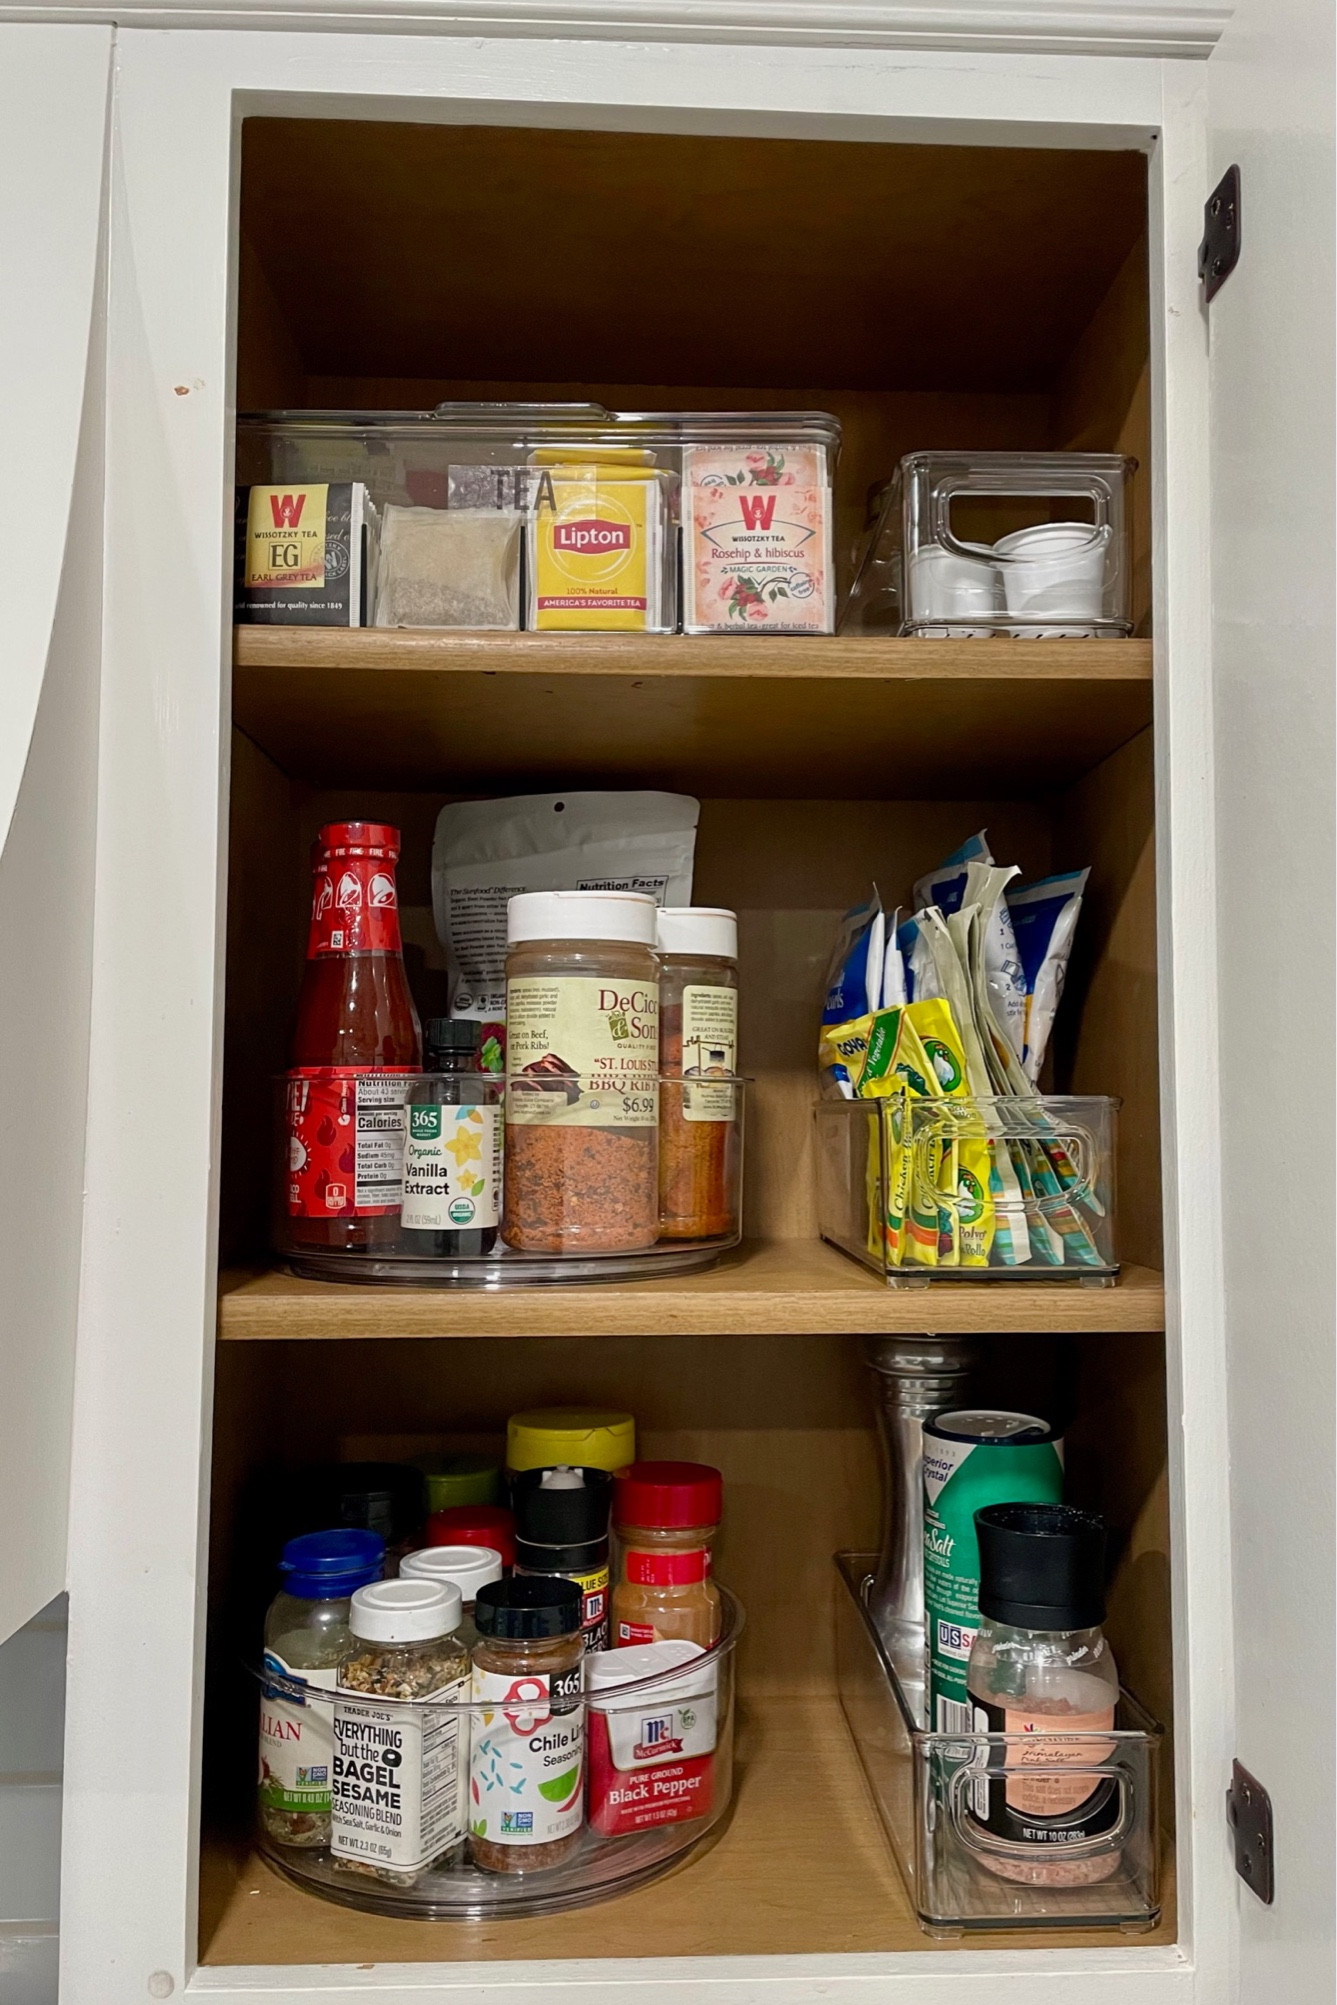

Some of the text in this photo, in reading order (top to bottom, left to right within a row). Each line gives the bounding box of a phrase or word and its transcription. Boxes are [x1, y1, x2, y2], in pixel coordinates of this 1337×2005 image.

[491, 470, 558, 512] TEA
[254, 531, 299, 540] WISSOTZKY
[302, 530, 318, 538] TEA
[560, 527, 624, 548] Lipton
[732, 535, 786, 543] WISSOTZKY TEA
[270, 543, 299, 568] EG
[711, 548, 805, 562] Rosehip & hibiscus
[251, 574, 273, 582] EARL
[275, 574, 298, 582] GREY
[300, 574, 317, 582] TEA
[589, 587, 618, 596] Natural
[246, 602, 342, 612] renowned for quality since 1849
[544, 598, 641, 607] AMERICA'S FAVORITE TEA
[369, 849, 384, 857] FIRE
[579, 878, 664, 890] Nutrition Facts
[531, 1029, 549, 1040] Beef,
[837, 1037, 868, 1058] GOYA
[358, 1088, 380, 1096] About
[622, 1096, 654, 1115] $6.99
[358, 1117, 402, 1129] Calories
[412, 1111, 438, 1128] 365
[357, 1152, 395, 1161] Sodium 45mg
[409, 1144, 442, 1160] Organic
[357, 1162, 372, 1170] Total
[406, 1162, 448, 1178] Vanilla
[357, 1172, 387, 1180] Protein 0g
[405, 1181, 450, 1196] Extract
[582, 1622, 608, 1646] BLAC
[555, 1673, 580, 1698] 365
[344, 1706, 391, 1722] TRADER JOE'S
[261, 1712, 302, 1742] LIAN
[334, 1717, 402, 1749] EVERYTHING
[529, 1734, 568, 1753] Chile
[636, 1741, 678, 1758] McCormick
[340, 1741, 380, 1763] but the
[333, 1755, 401, 1790] BAGEL
[629, 1767, 684, 1785] PURE GROUND
[332, 1778, 401, 1810] SESAME
[609, 1776, 702, 1805] Black Pepper
[332, 1797, 402, 1826] SEASONING BLEND
[342, 1816, 402, 1838] Sea Salt, Garlic & Onion
[1023, 1827, 1036, 1839] NET
[1036, 1829, 1048, 1840] WT
[1049, 1831, 1057, 1842] 10
[1058, 1831, 1067, 1842] OZ
[338, 1835, 348, 1846] NET
[360, 1840, 369, 1852] 2.3
[370, 1842, 378, 1854] OZ
